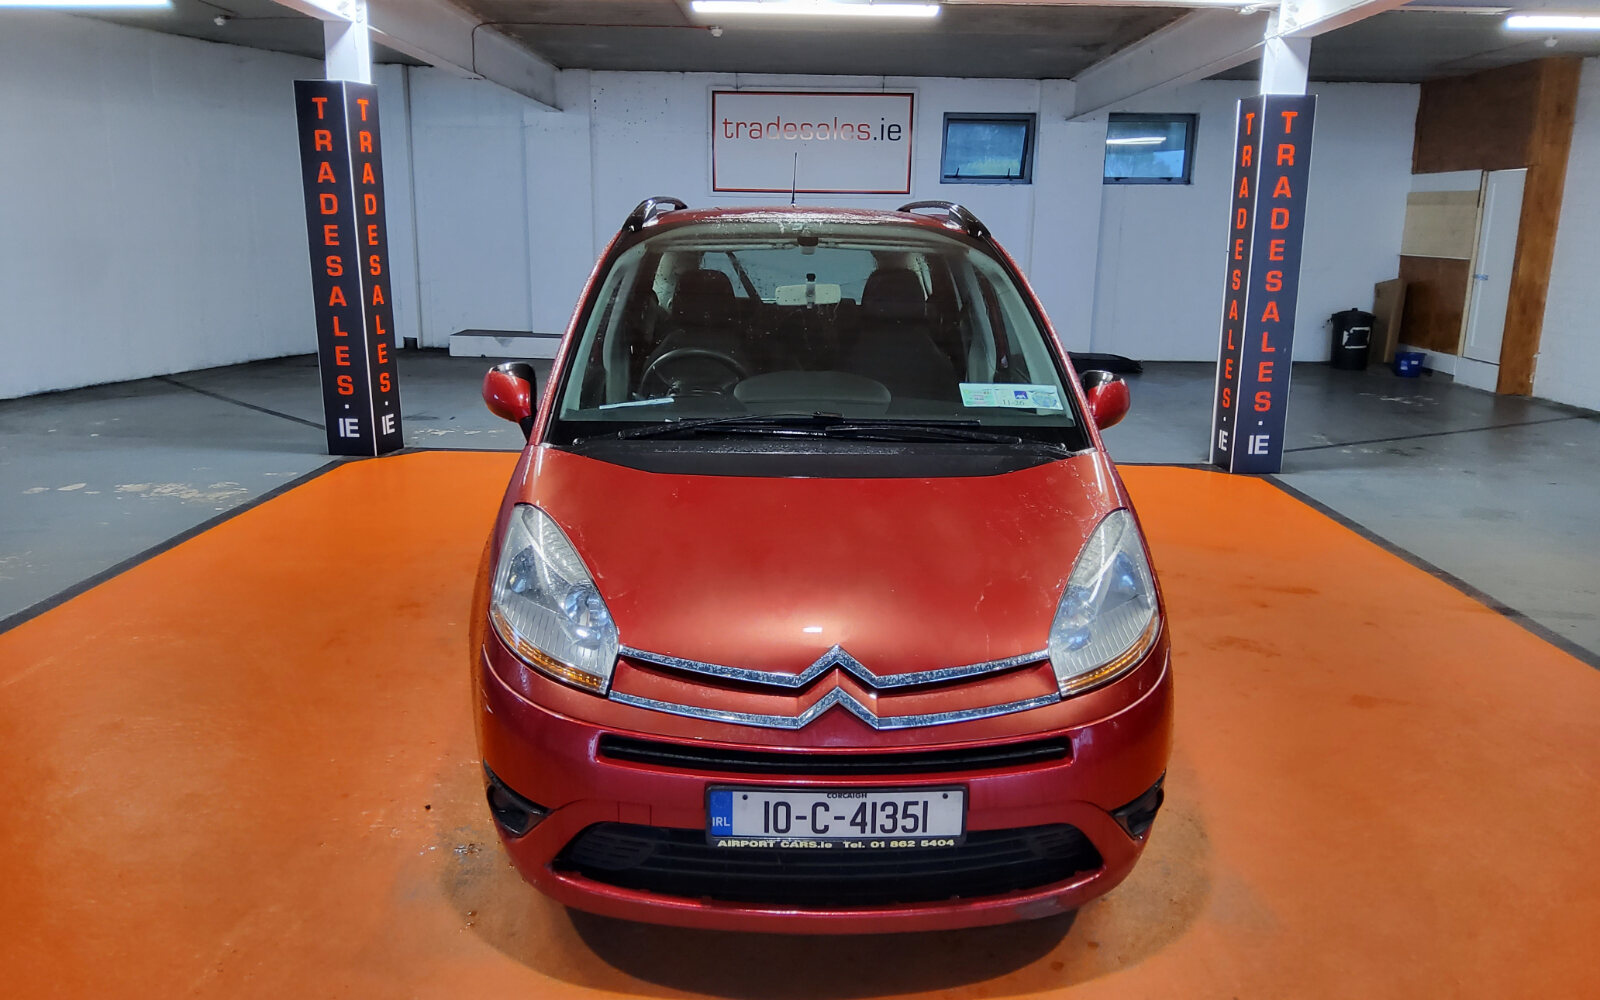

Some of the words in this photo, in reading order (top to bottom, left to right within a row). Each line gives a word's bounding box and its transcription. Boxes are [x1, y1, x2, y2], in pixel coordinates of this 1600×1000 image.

[722, 115, 902, 142] tradesales.ie
[712, 817, 731, 827] IRL
[764, 801, 929, 834] 10-C-41351
[717, 839, 775, 848] AIRPORT
[843, 841, 865, 849] Tel.
[890, 840, 915, 848] 862
[921, 839, 955, 847] 5404
